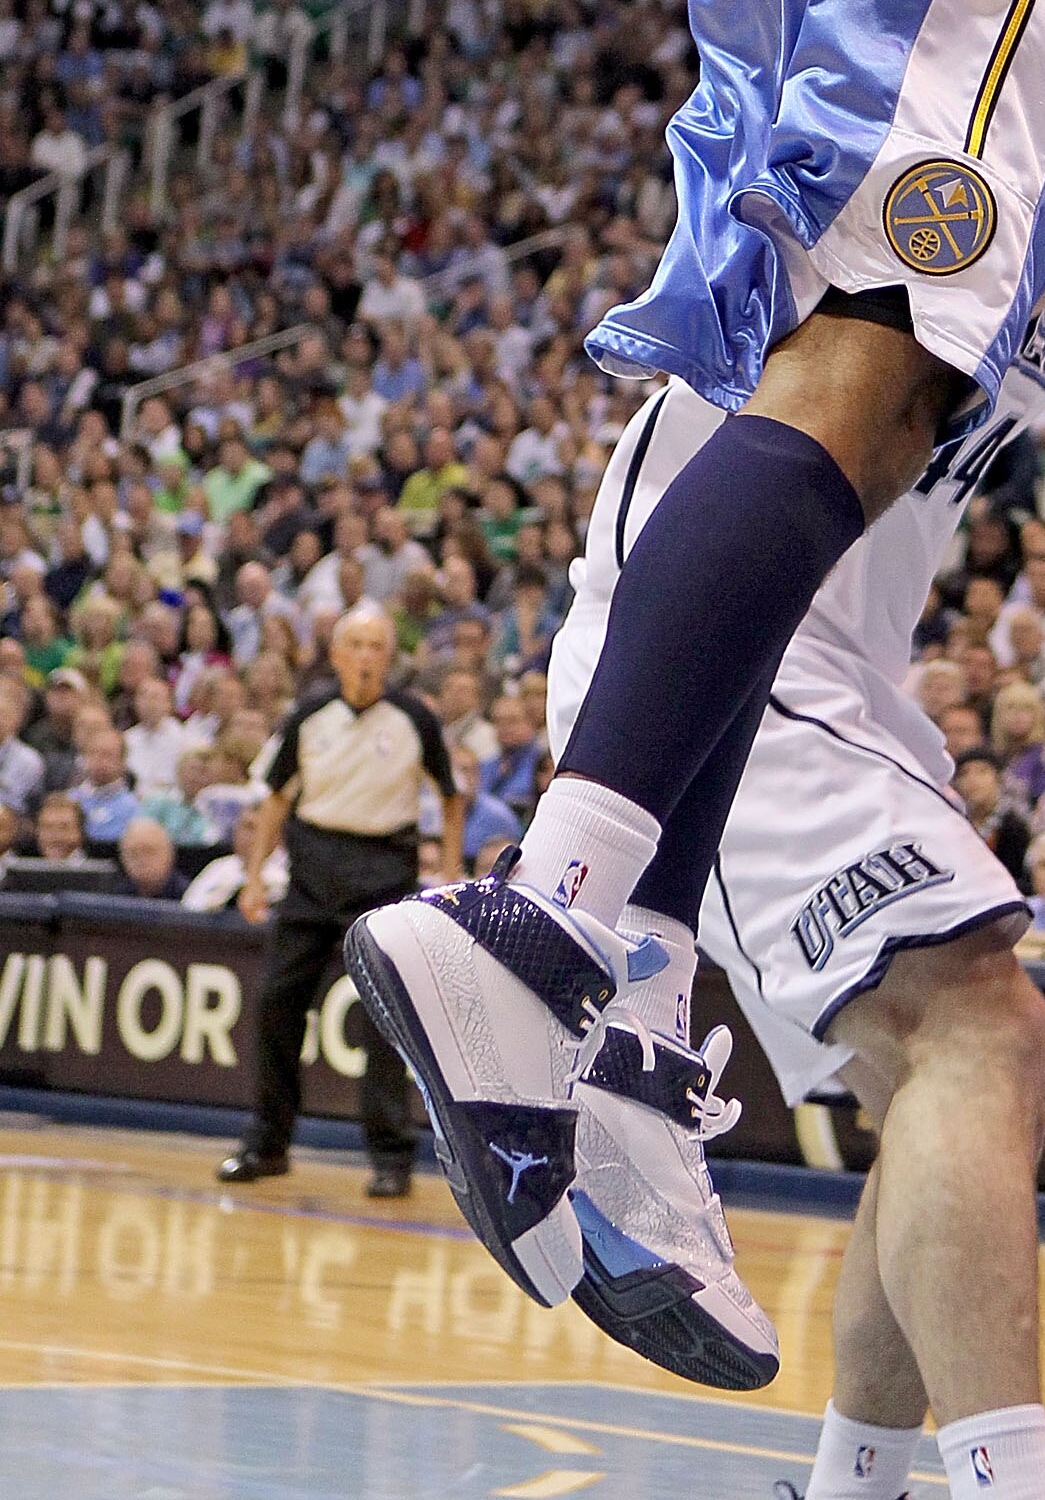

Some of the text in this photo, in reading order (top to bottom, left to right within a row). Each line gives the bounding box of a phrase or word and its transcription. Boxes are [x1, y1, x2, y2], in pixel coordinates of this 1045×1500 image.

[788, 838, 956, 972] UTAH
[0, 951, 109, 1056] IN
[116, 957, 243, 1068] OR
